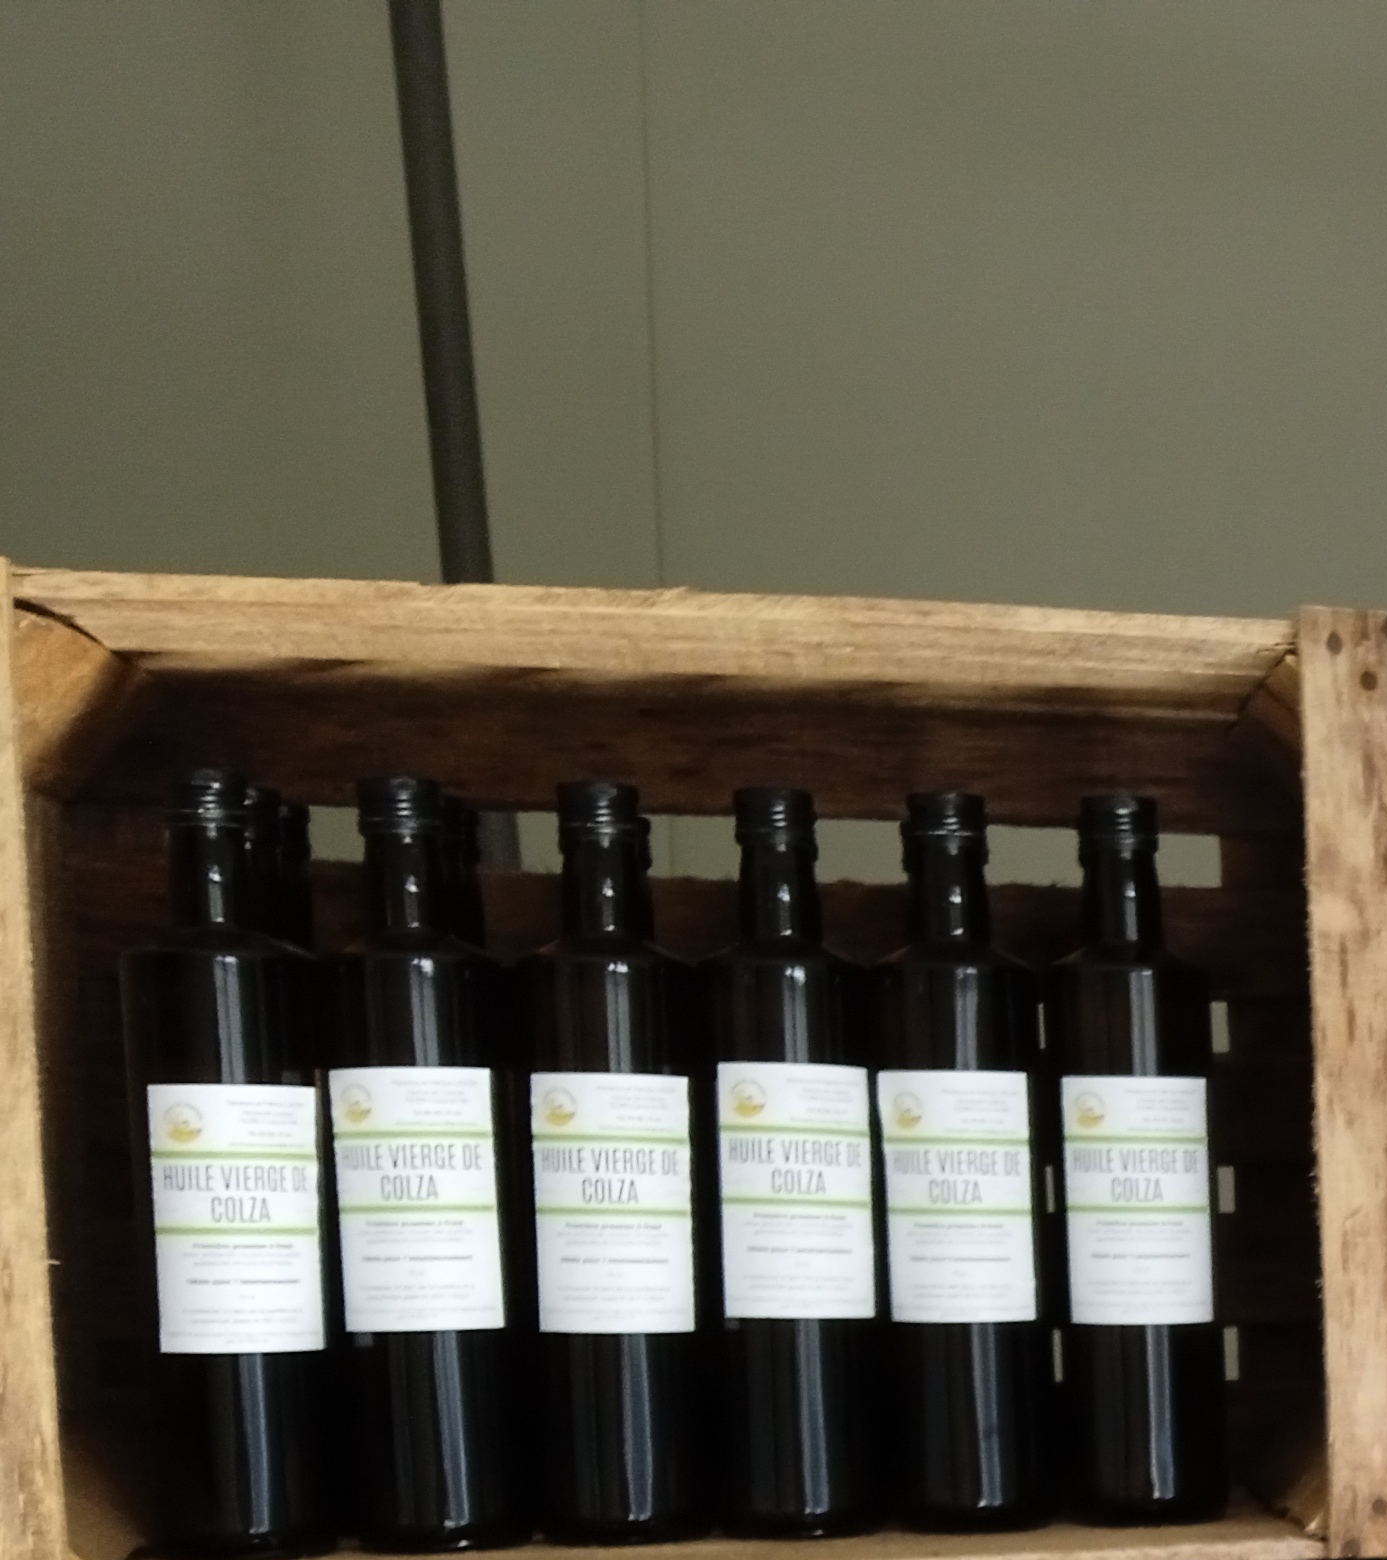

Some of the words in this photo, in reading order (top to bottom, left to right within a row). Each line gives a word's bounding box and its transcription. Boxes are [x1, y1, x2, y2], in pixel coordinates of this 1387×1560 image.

[342, 1144, 383, 1170] HUILE
[389, 1143, 456, 1169] VIERGE
[462, 1143, 482, 1168] DE
[541, 1148, 586, 1172] HUILE
[591, 1149, 657, 1174] VIERGE
[661, 1150, 679, 1175] DE
[728, 1139, 775, 1164] HUILE
[781, 1140, 842, 1166] VIERGE
[846, 1141, 863, 1168] DE
[893, 1152, 931, 1175] HUILE
[936, 1151, 998, 1175] VIERGE
[1003, 1152, 1021, 1176] DE
[1073, 1148, 1114, 1172] HUILE
[1119, 1148, 1180, 1172] VIERGE
[1184, 1148, 1199, 1172] DE
[163, 1165, 215, 1192] HUILE
[220, 1166, 288, 1192] VIERGE
[292, 1167, 308, 1193] DE
[380, 1174, 438, 1201] COLZA
[581, 1179, 638, 1204] COLZA
[771, 1169, 826, 1194] COLZA
[928, 1179, 983, 1205] COLZA
[1110, 1177, 1163, 1202] COLZA
[210, 1196, 272, 1223] COLZA
